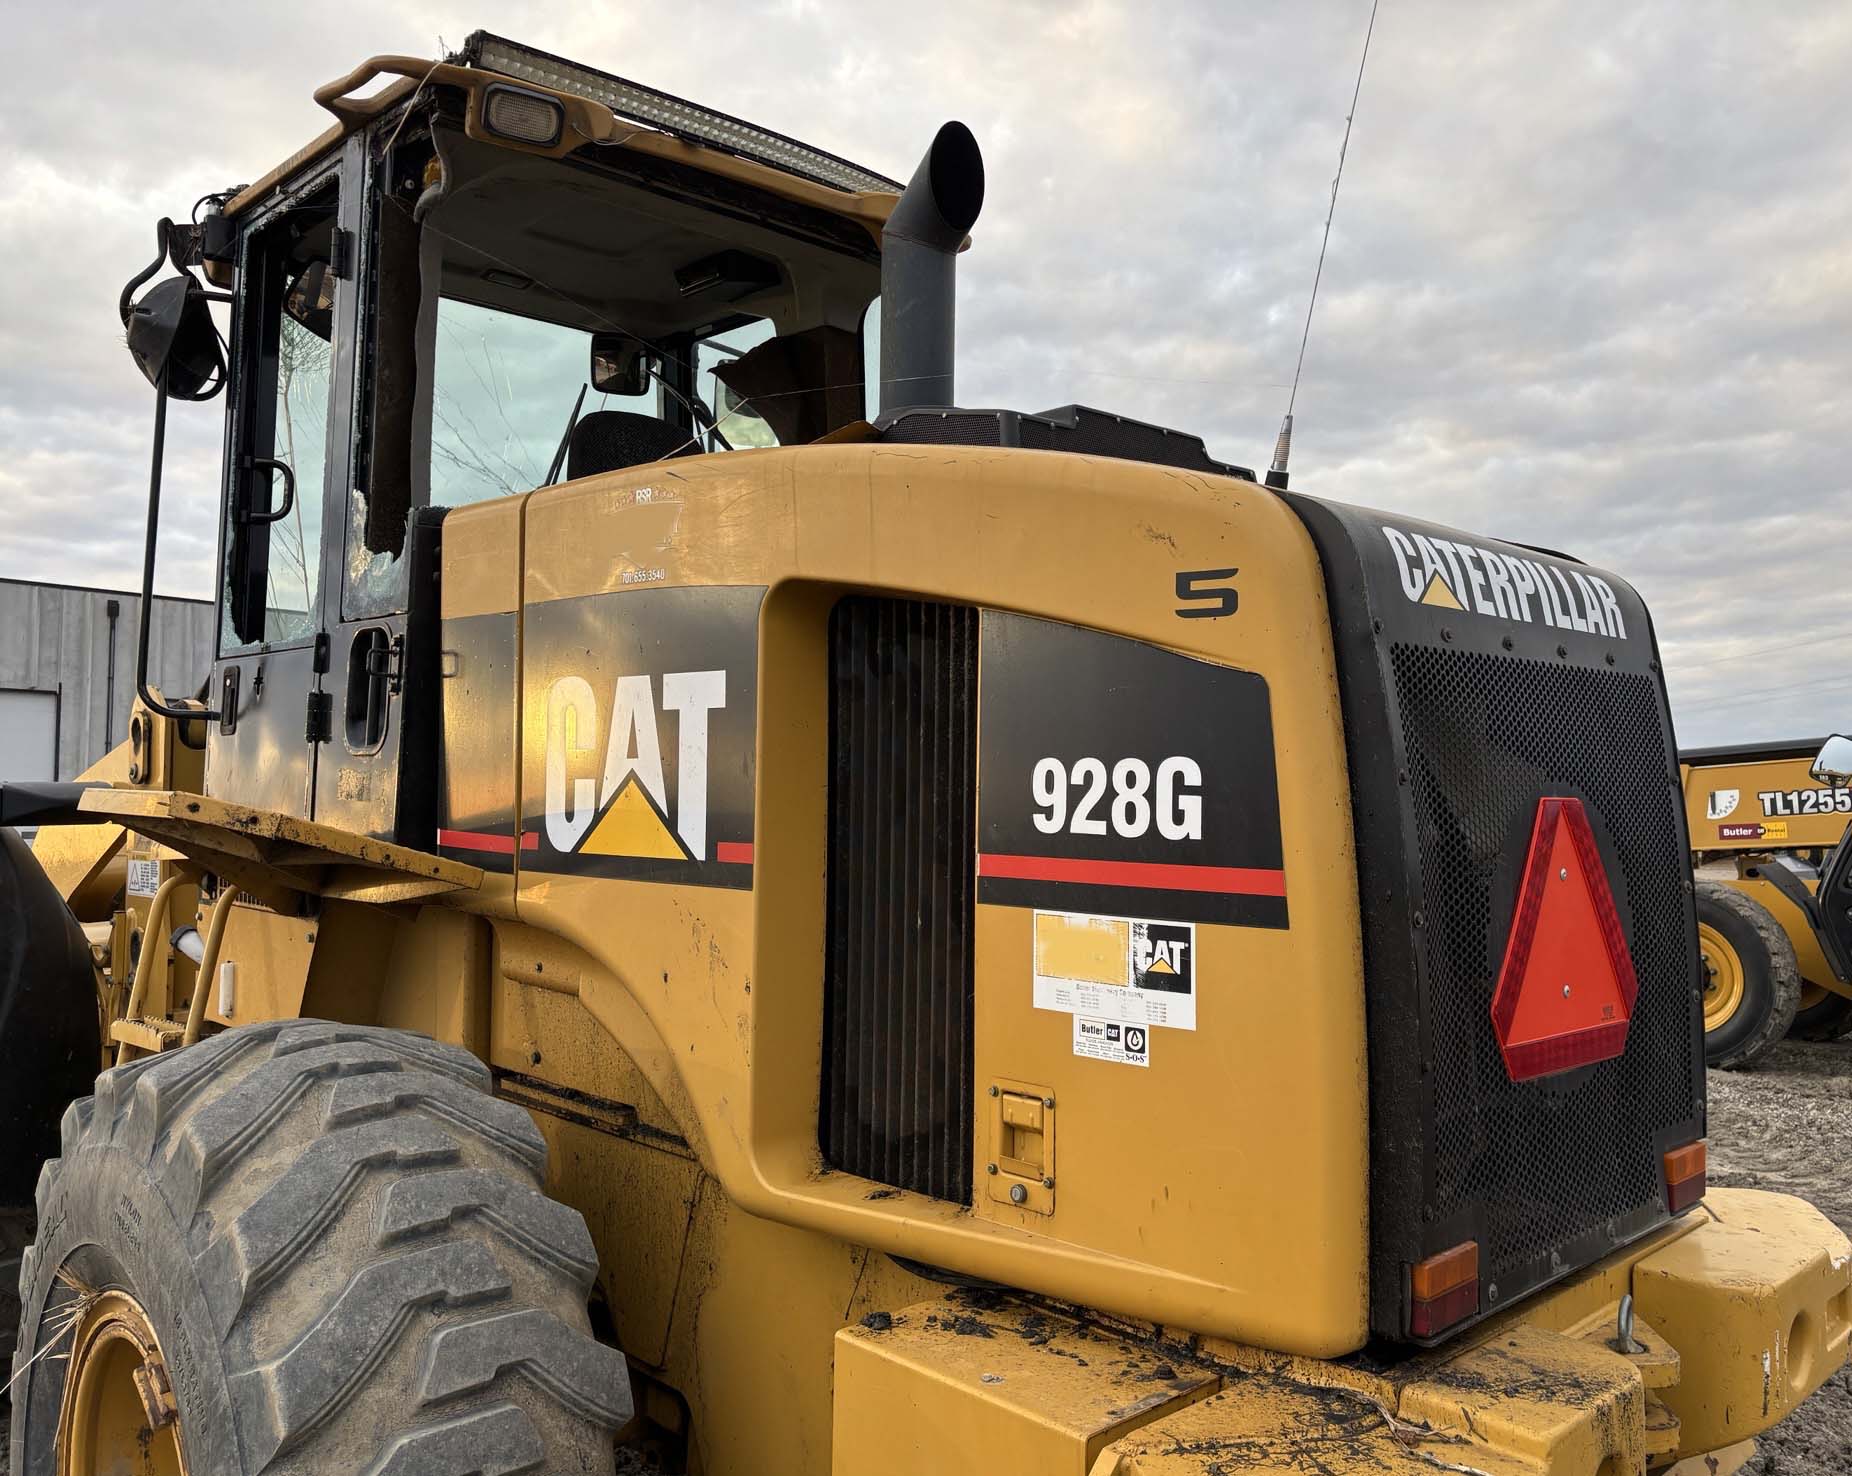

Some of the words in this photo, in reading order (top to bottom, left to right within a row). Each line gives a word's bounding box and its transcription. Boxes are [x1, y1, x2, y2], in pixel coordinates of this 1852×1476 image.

[1382, 526, 1628, 640] CATERPILLAR
[545, 670, 726, 861] CAT
[1032, 756, 1202, 840] 928G
[1758, 787, 1852, 817] TL1255
[1723, 828, 1753, 836] Butler
[1136, 939, 1185, 975] CAT
[1081, 1023, 1104, 1036] Butler
